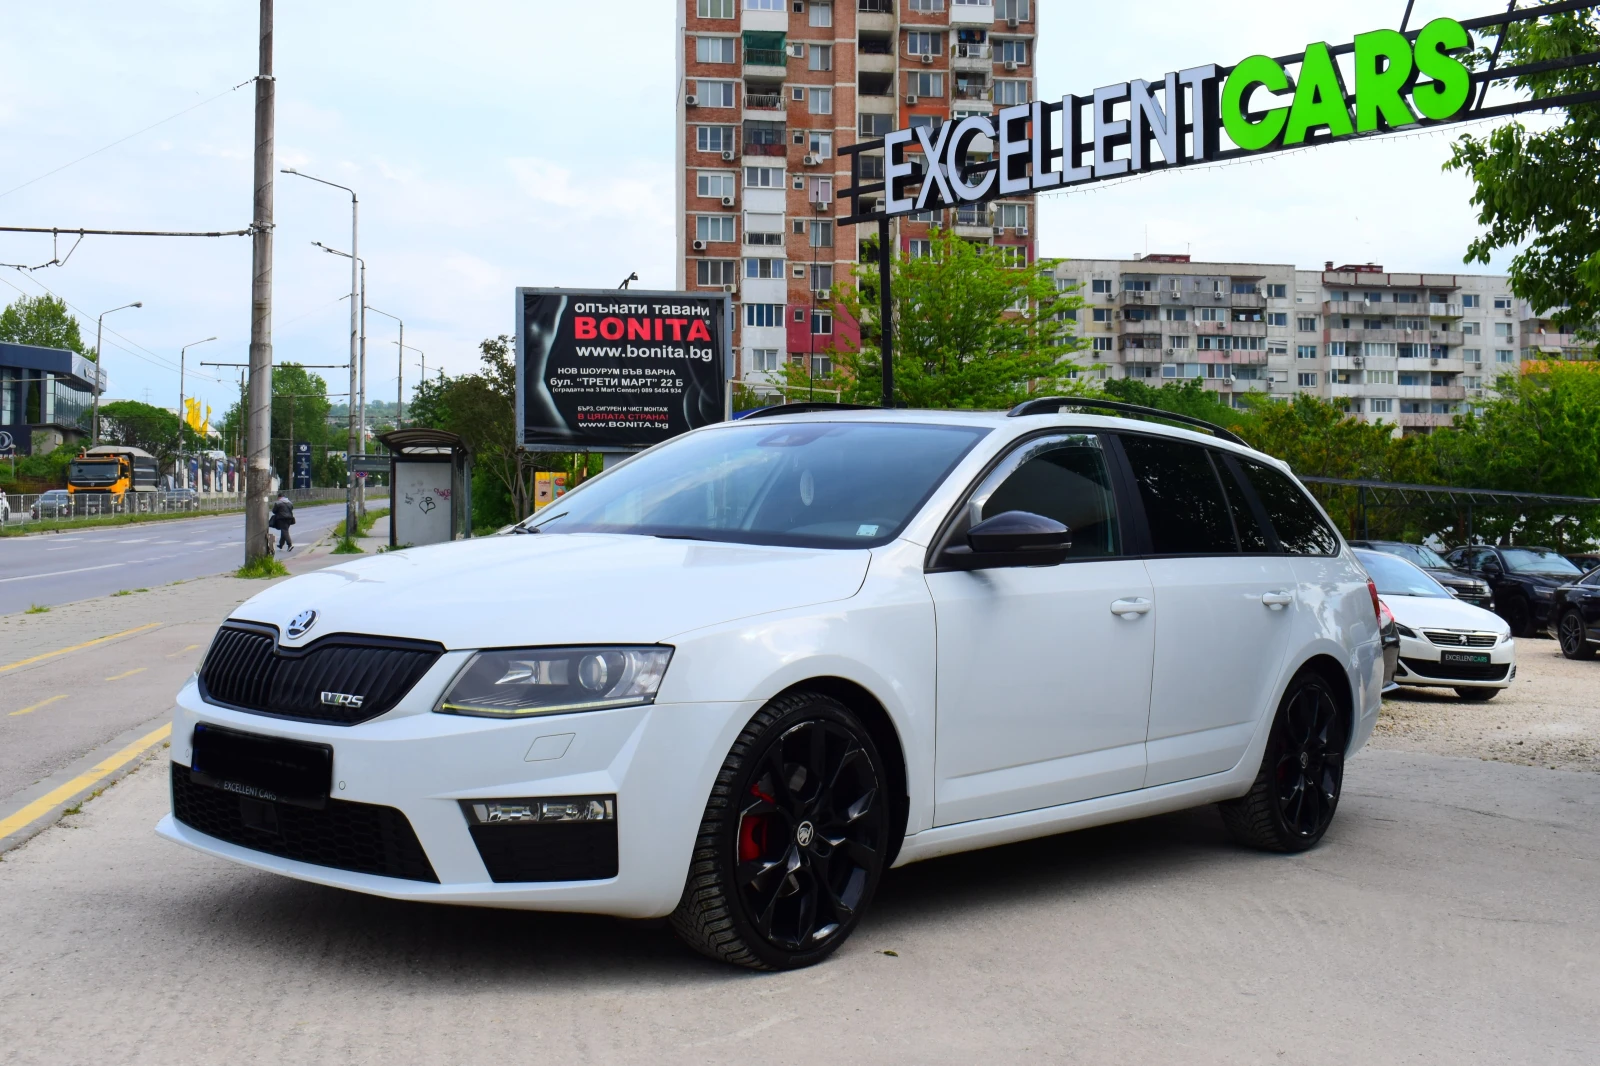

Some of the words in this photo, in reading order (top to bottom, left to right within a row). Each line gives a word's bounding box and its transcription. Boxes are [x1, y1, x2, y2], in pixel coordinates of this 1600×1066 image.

[574, 302, 648, 315] опънати
[652, 304, 710, 317] тавани
[574, 316, 711, 342] BONITA
[575, 344, 713, 362] www.bonita.bg
[557, 367, 578, 375] НОВ
[580, 367, 620, 375] ШОУРУМ
[622, 368, 643, 376] ВЪВ
[644, 368, 677, 376] ВАРНА
[550, 377, 574, 388] бул.
[660, 378, 673, 387] 22
[675, 378, 684, 387] Б
[587, 413, 626, 421] ЦЯЛАТА
[627, 413, 669, 421] СТРАНА!
[578, 421, 669, 430] www.BONITA.bg
[223, 780, 258, 797] EXCELLENT
[259, 788, 277, 801] CARS
